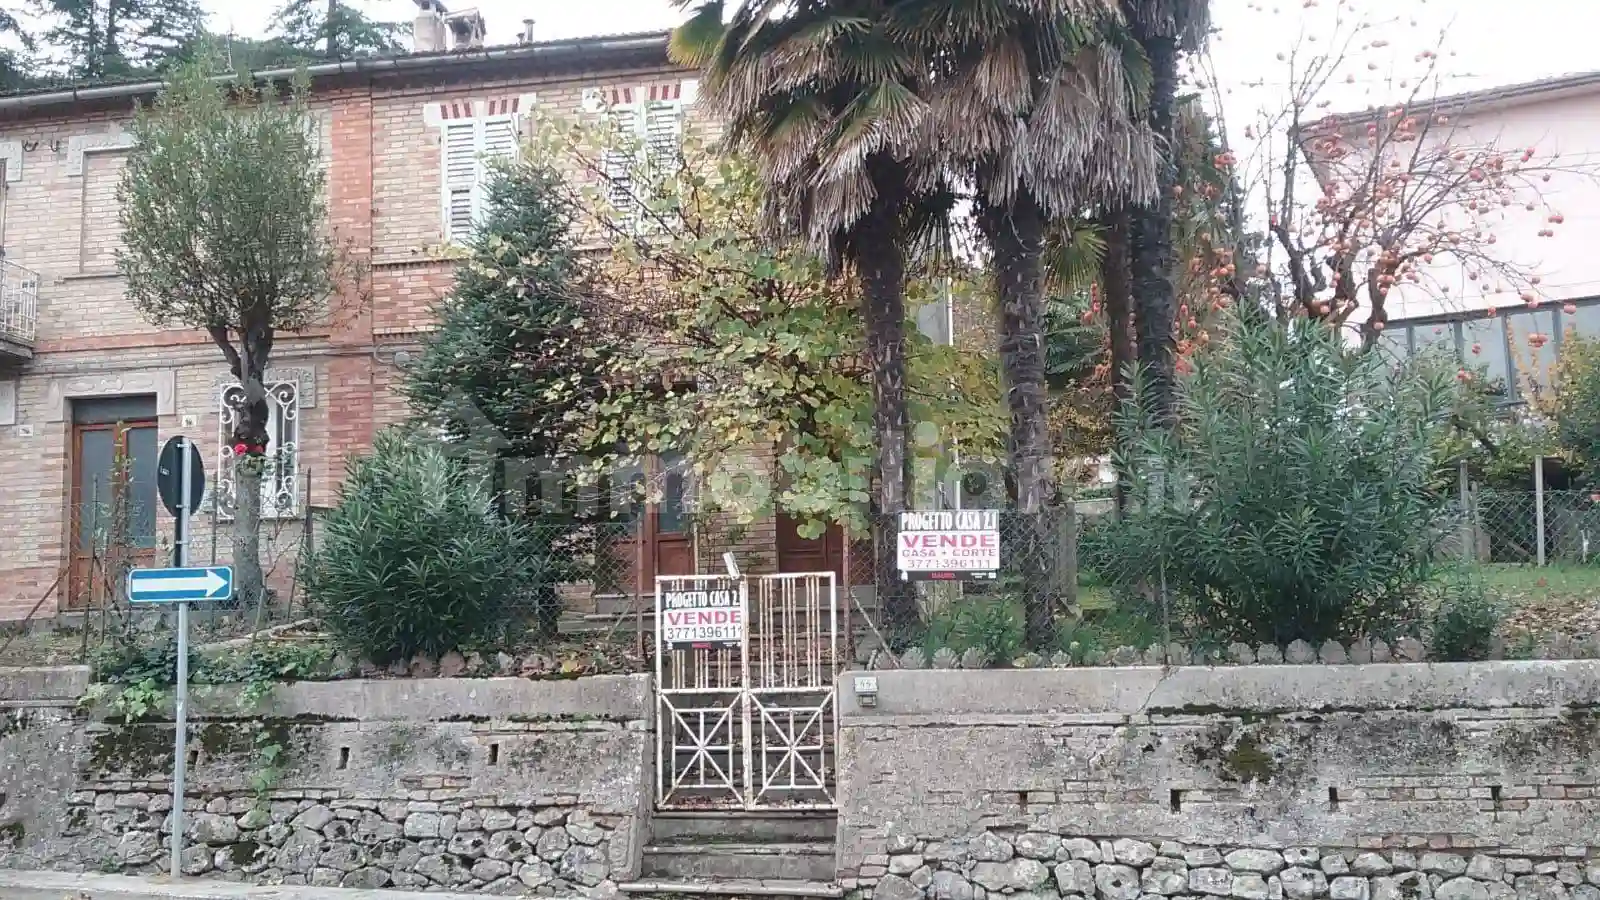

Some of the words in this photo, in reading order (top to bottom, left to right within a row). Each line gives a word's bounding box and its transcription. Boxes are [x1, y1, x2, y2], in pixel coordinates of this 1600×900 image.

[902, 512, 953, 531] PROGETTO
[955, 512, 981, 530] CASA
[902, 534, 996, 548] VENDE
[902, 549, 936, 557] CASA
[952, 549, 996, 557] CORTE
[907, 559, 991, 568] 3771396111
[665, 592, 708, 608] PROGETTO
[709, 591, 730, 607] CASA
[667, 610, 741, 626] VENDE
